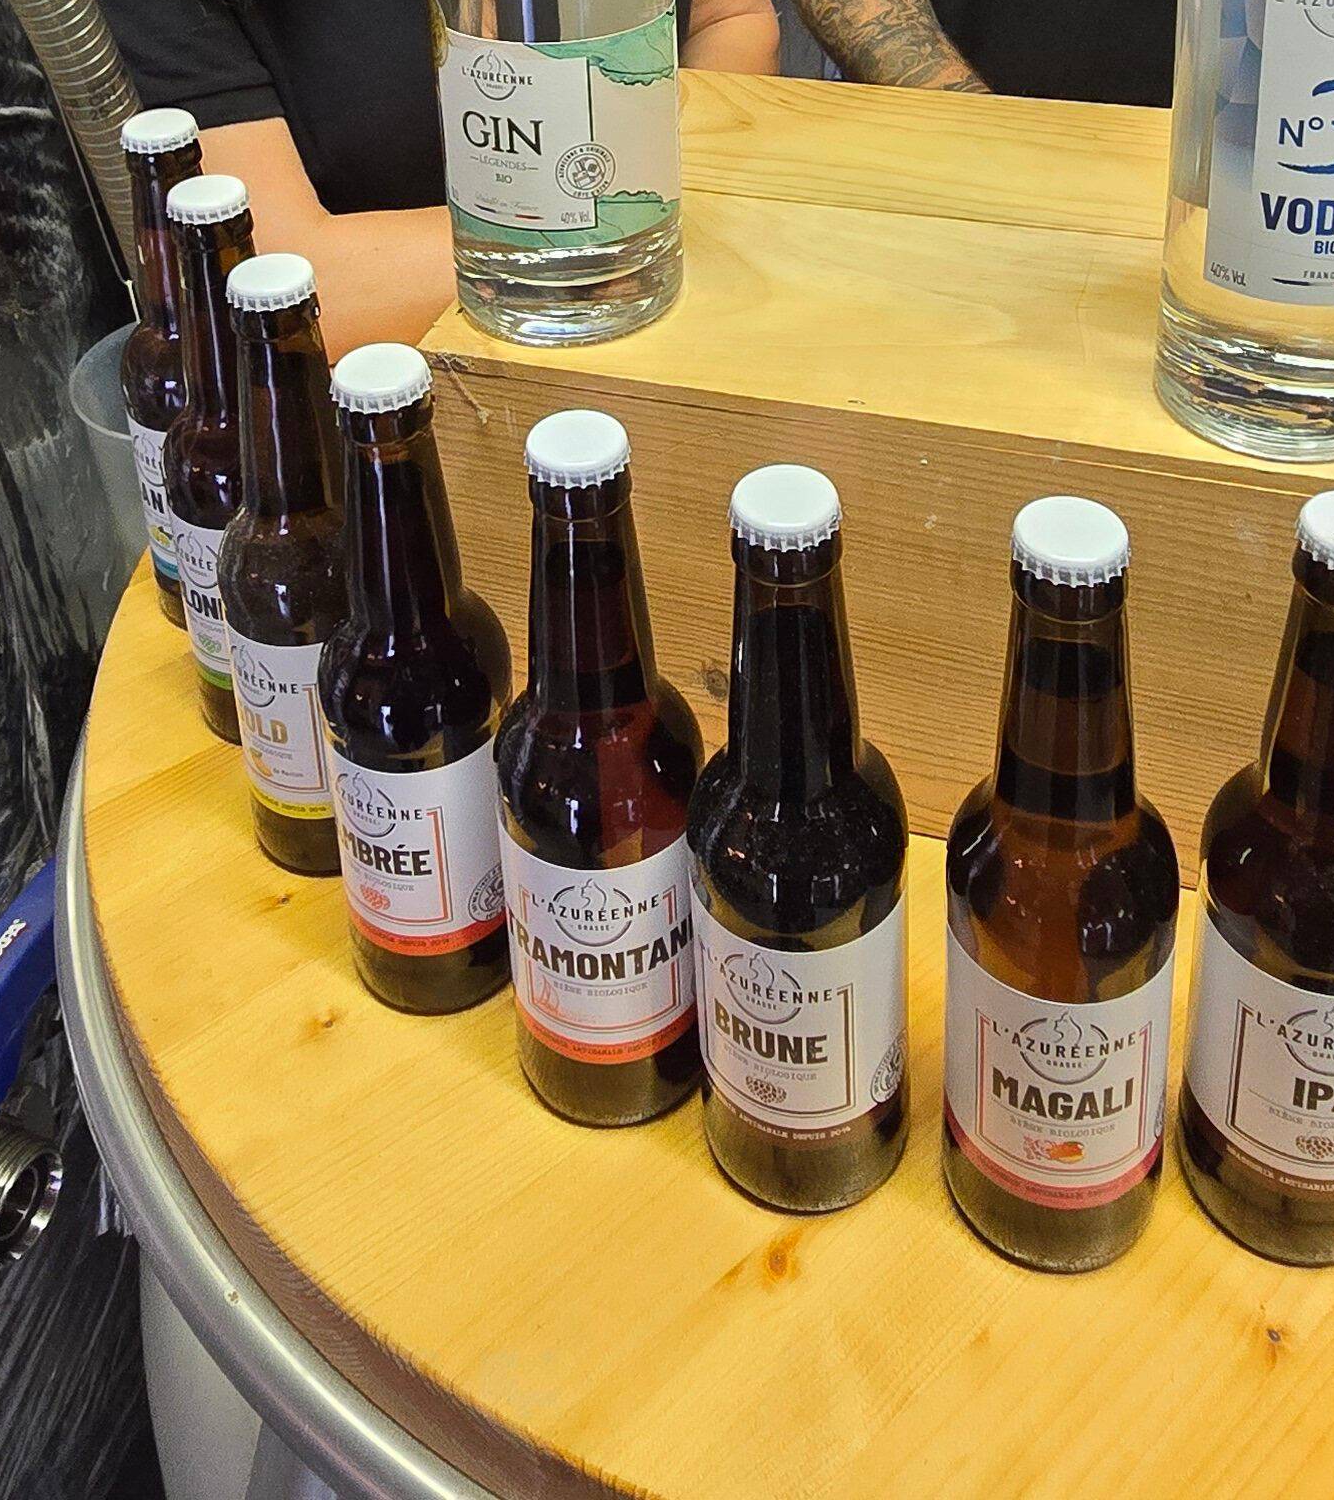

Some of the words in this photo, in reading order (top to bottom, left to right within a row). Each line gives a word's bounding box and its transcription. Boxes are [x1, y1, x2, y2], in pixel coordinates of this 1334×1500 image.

[462, 66, 533, 86] L'AZURÉENNE
[462, 110, 544, 156] GIN
[495, 173, 513, 184] BIO
[1210, 262, 1230, 281] 40%
[239, 705, 290, 746] OLD
[341, 824, 433, 877] MBRÉE
[532, 893, 660, 922] L'AZURÉENNE
[714, 997, 829, 1064] BRUNE
[992, 1020, 1137, 1059] L'AZURÉENNE
[992, 1066, 1135, 1122] MAGALI
